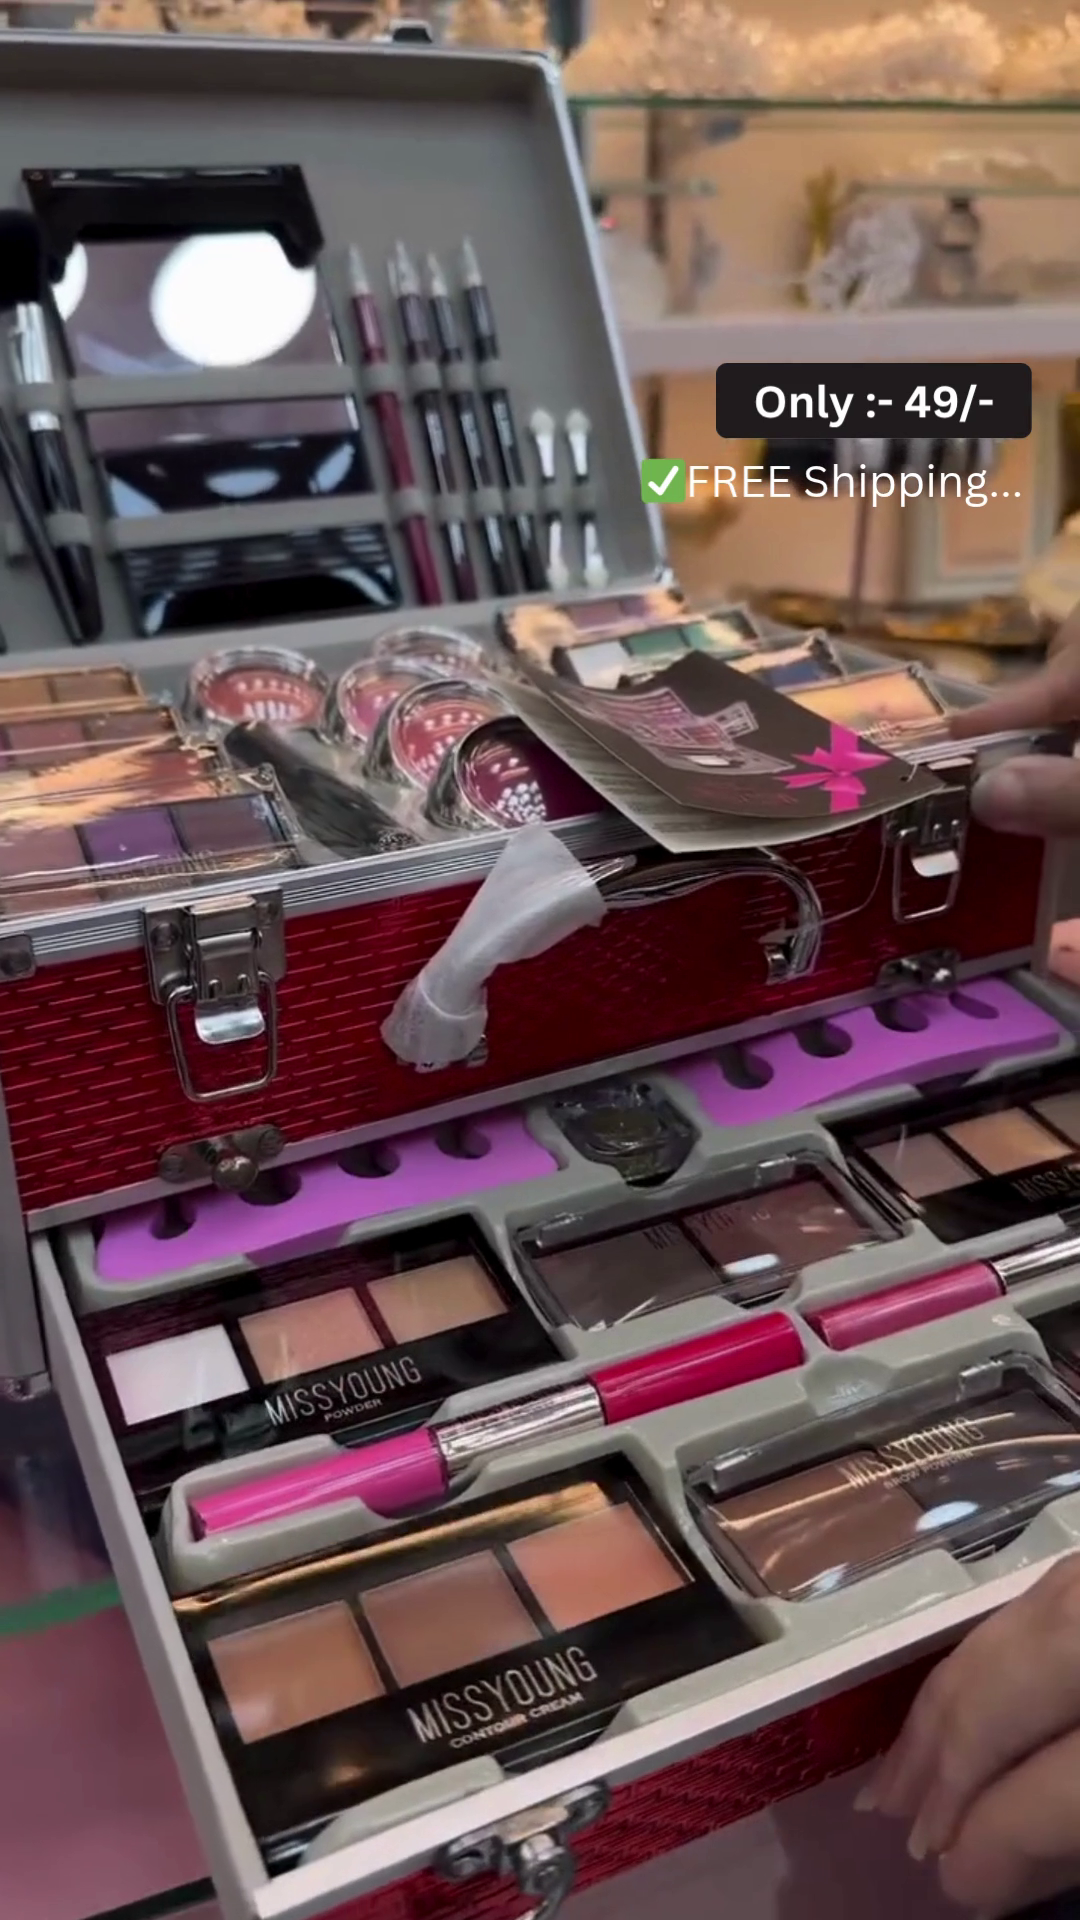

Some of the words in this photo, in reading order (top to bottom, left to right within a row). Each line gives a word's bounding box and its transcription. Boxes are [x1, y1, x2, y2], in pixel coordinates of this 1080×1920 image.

[264, 1355, 422, 1427] MISSYOUNG
[323, 1398, 384, 1423] POWDER
[834, 1416, 986, 1488] MISSYOUNG
[406, 1646, 598, 1743] MISSYOUNG
[449, 1712, 529, 1749] CONTOUR
[529, 1691, 585, 1719] CREAM
